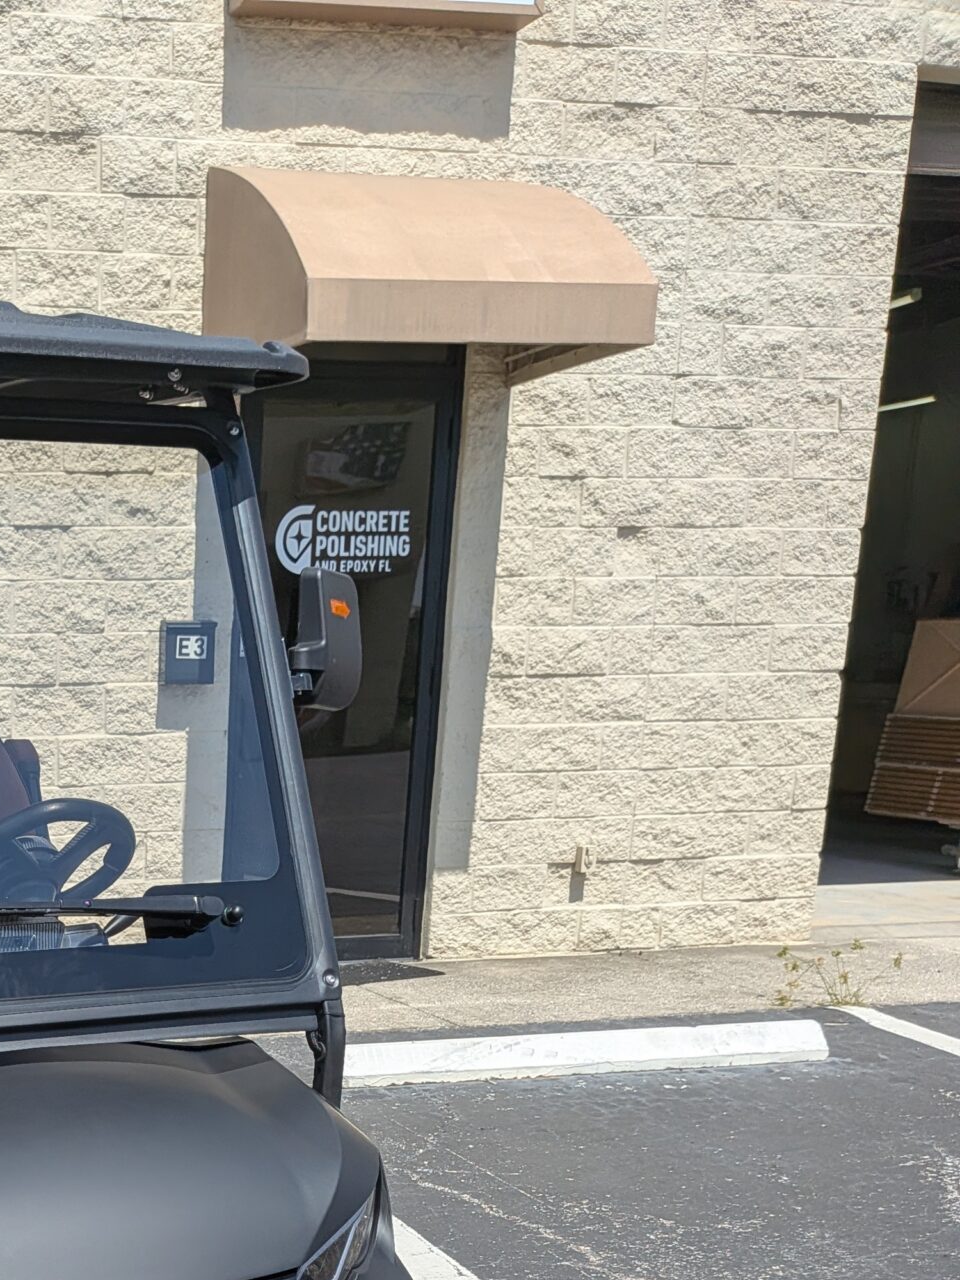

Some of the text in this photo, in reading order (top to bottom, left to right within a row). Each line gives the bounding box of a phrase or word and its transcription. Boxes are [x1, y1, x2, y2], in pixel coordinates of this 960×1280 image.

[316, 510, 410, 532] CONCRETE
[315, 535, 410, 557] POLISHING
[340, 560, 377, 572] EPOXY
[378, 560, 392, 572] FL
[178, 637, 205, 657] E3
